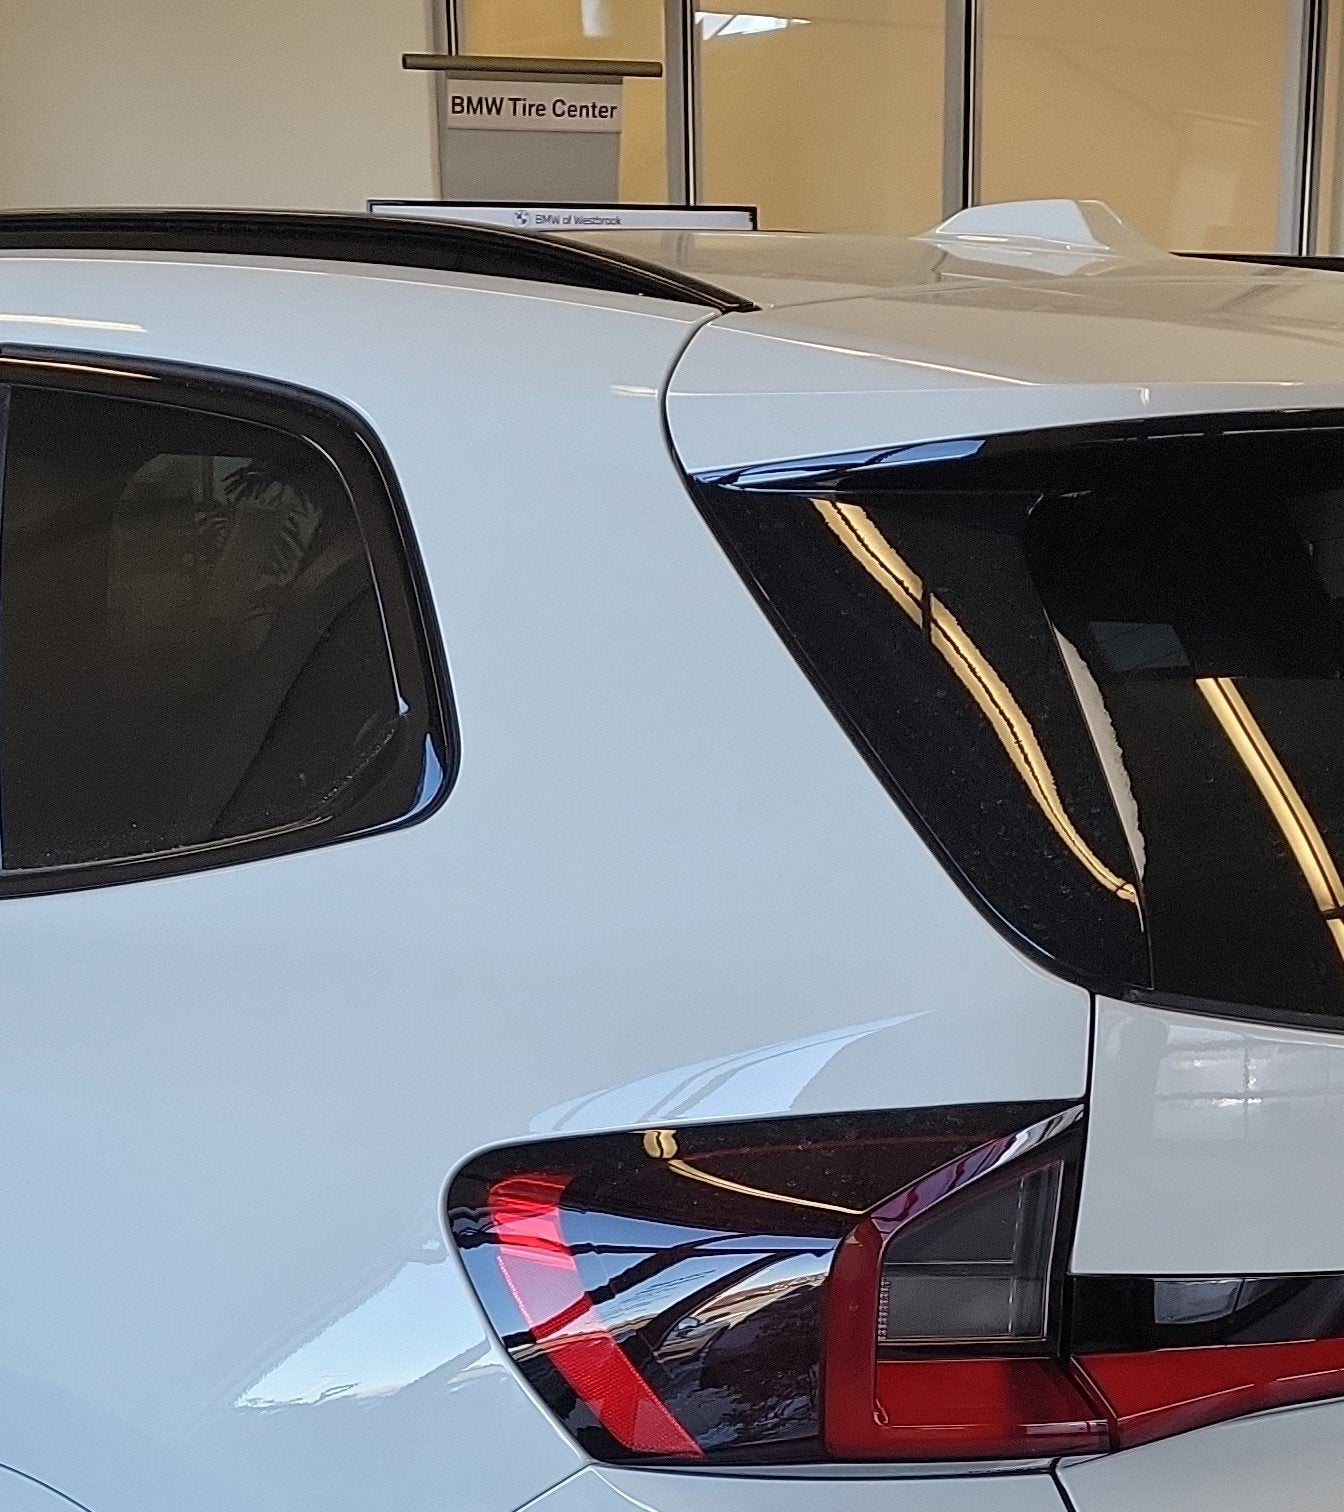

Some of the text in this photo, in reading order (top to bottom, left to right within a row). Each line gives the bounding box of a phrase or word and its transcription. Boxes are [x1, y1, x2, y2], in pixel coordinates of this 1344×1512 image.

[451, 95, 618, 119] BMW Tire Center
[535, 214, 560, 225] BMW
